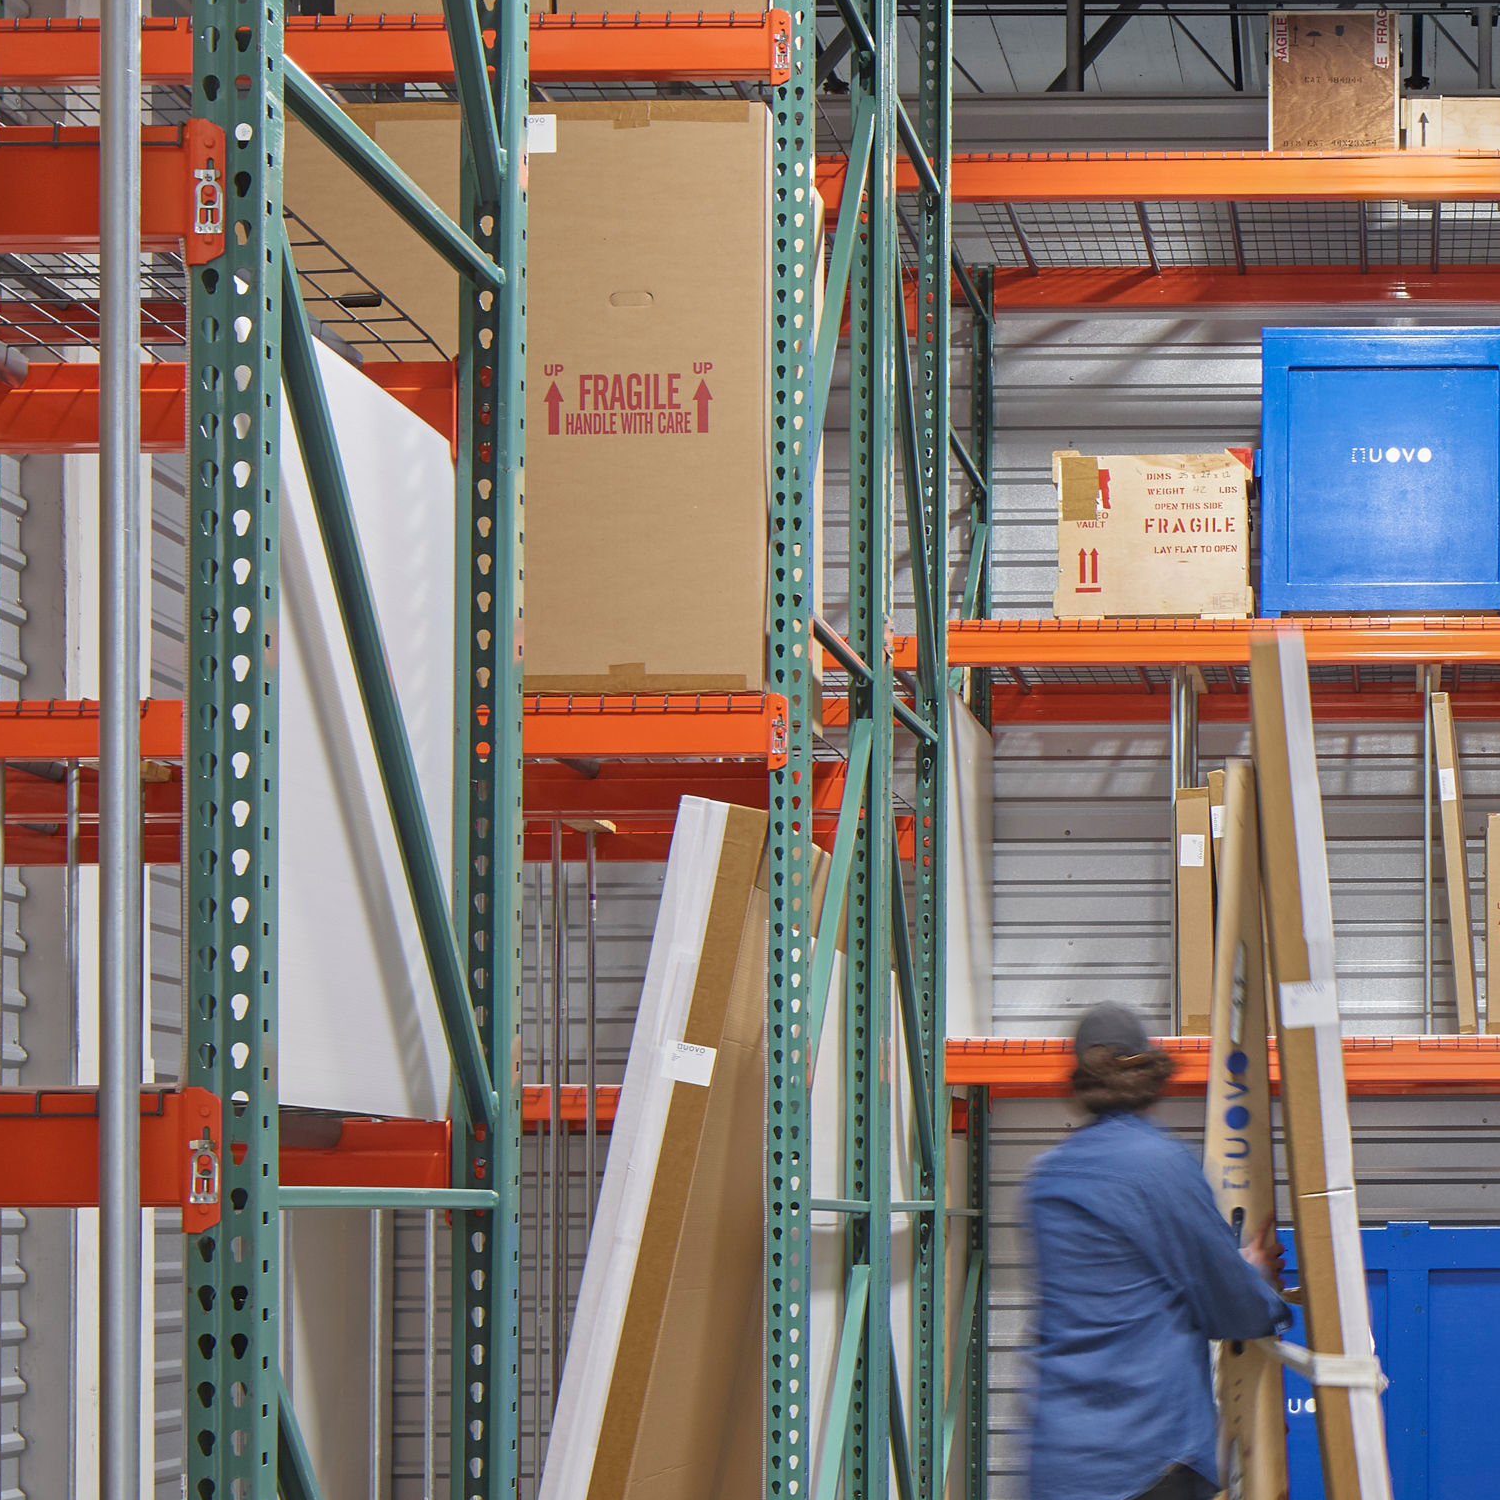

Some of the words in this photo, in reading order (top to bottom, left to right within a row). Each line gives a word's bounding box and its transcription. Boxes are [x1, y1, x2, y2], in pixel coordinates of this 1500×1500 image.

[1376, 10, 1388, 44] FRAG
[1276, 17, 1287, 62] RAGILE
[544, 364, 564, 376] UP
[693, 362, 713, 374] UP
[579, 373, 681, 411] FRAGILE
[566, 412, 617, 435] HANDLE
[620, 412, 653, 435] WITH
[657, 411, 692, 435] CARE
[1369, 447, 1432, 463] UOVO
[1146, 472, 1172, 481] DIMS
[1147, 487, 1185, 496] WEIGHT
[1219, 486, 1238, 494] LBS
[1154, 502, 1179, 511] OPEN
[1180, 502, 1201, 510] THIS
[1203, 501, 1223, 510] SIDE
[1076, 520, 1106, 529] VAULT
[1144, 517, 1236, 534] FRAGILE
[1154, 545, 1172, 554] LAY
[1175, 545, 1198, 554] FLAT
[1201, 545, 1212, 553] TO
[1214, 545, 1238, 553] OPEN
[683, 1044, 706, 1054] UOVO
[1288, 1398, 1317, 1413] UO
